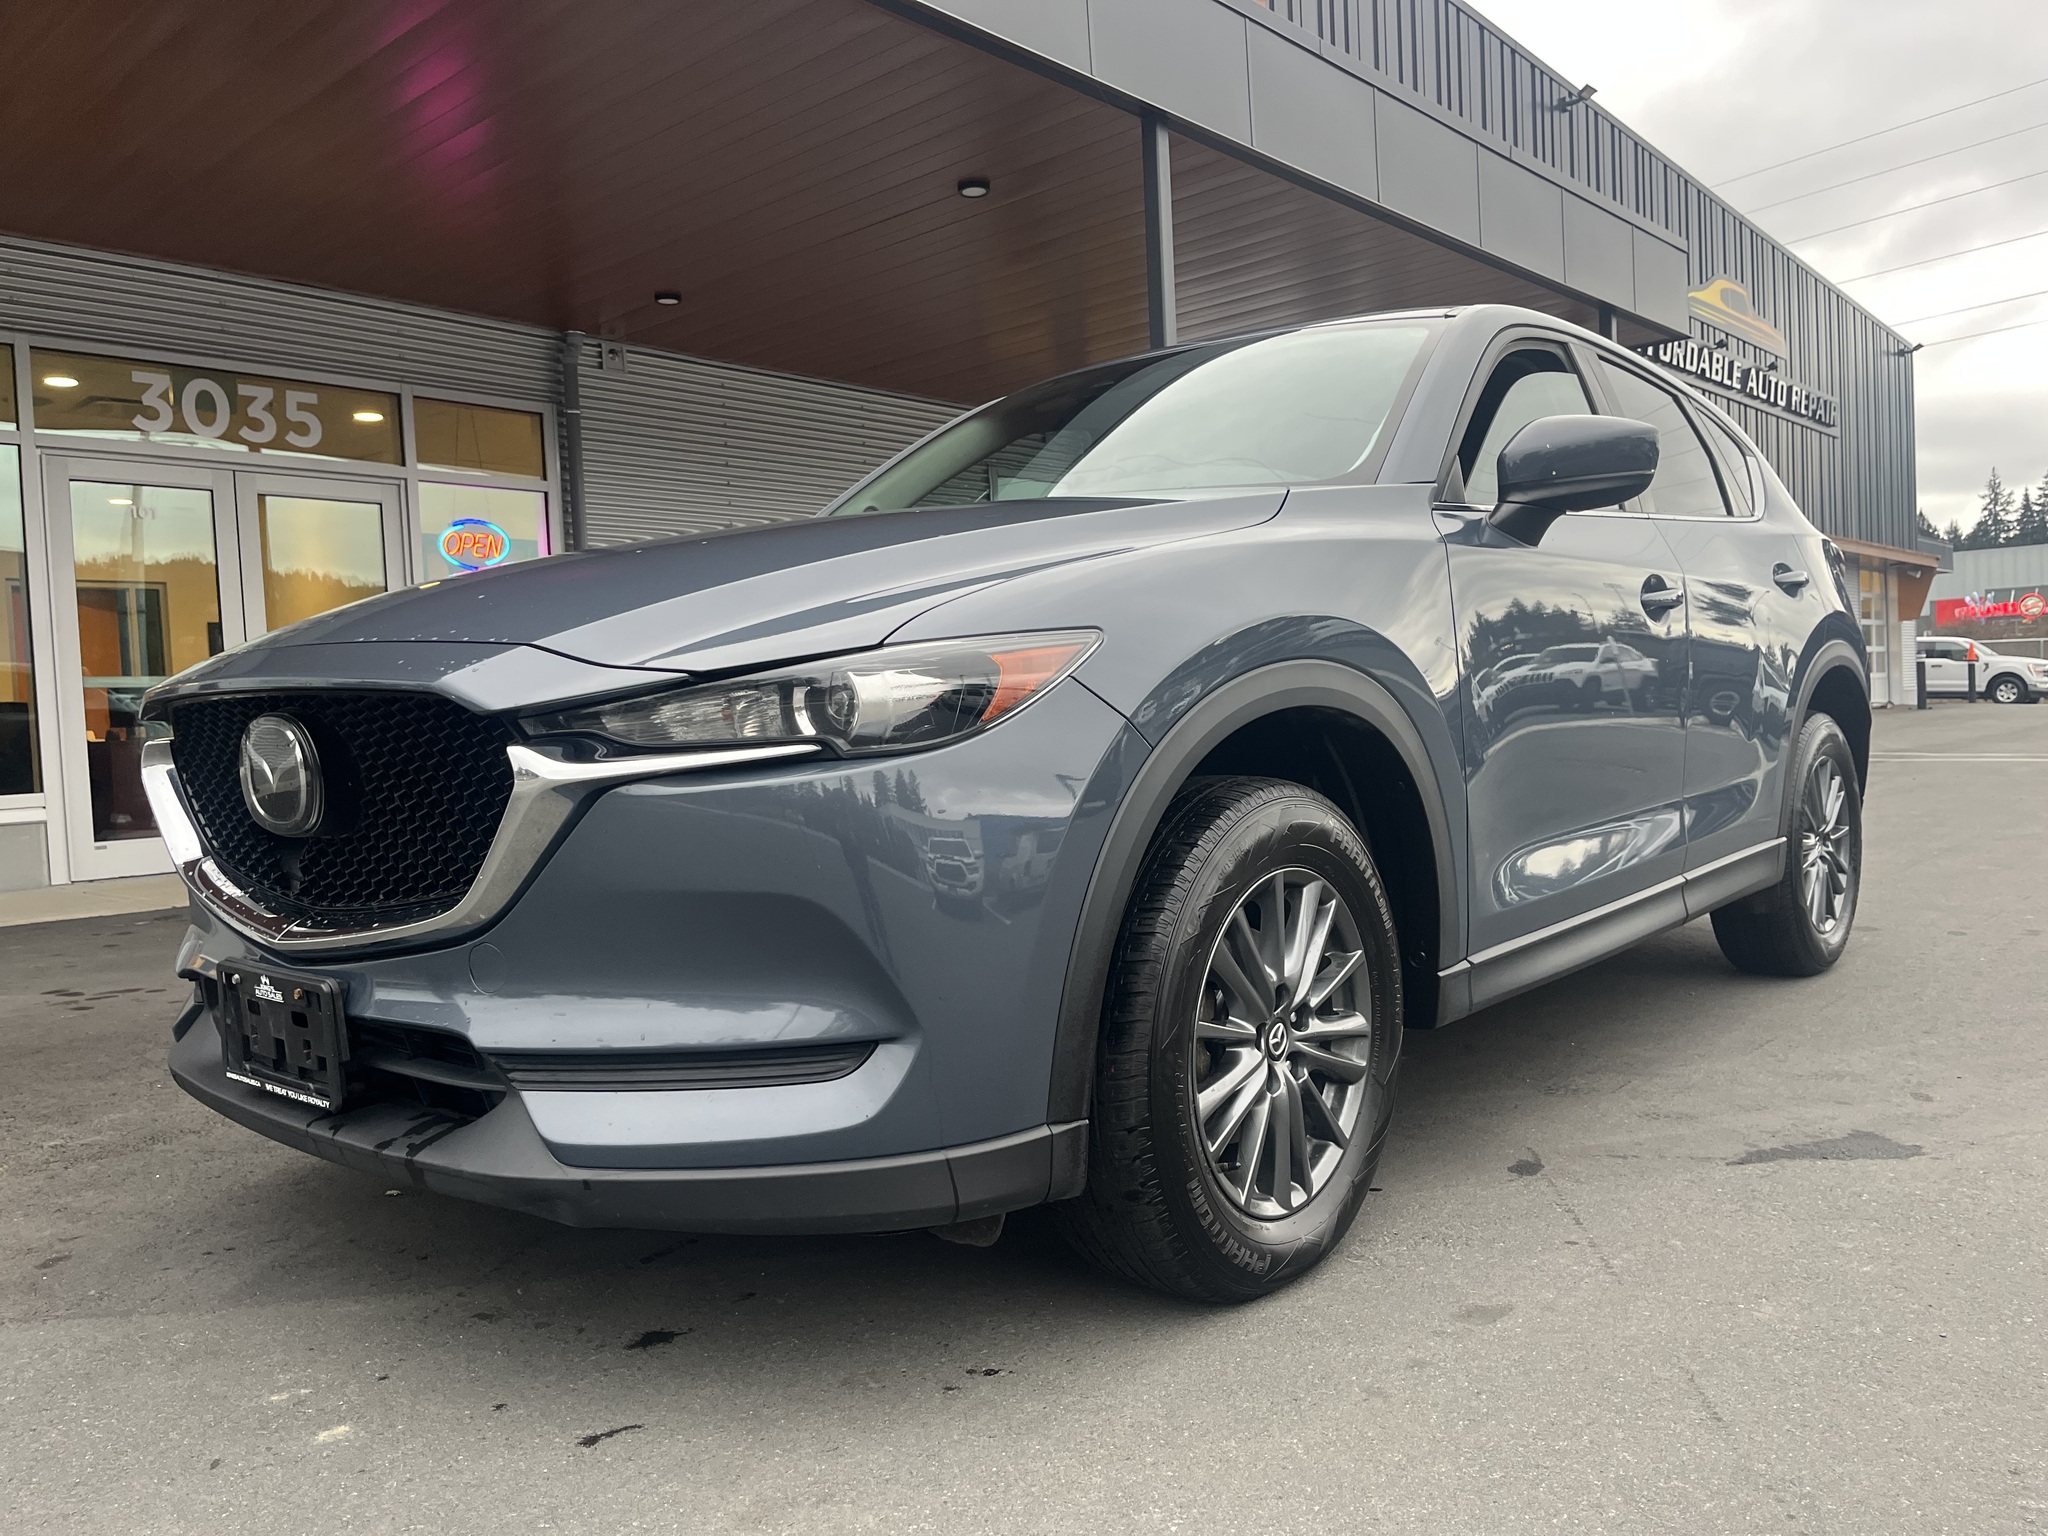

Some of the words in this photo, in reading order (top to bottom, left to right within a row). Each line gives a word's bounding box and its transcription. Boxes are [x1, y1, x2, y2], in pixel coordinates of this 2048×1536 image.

[131, 371, 322, 448] 3035
[1746, 367, 1787, 408] AUTO
[1791, 385, 1838, 427] REPAIR
[443, 531, 503, 558] OPEN
[265, 1083, 274, 1092] WE
[273, 1086, 287, 1096] TREAT
[287, 1090, 298, 1100] YOU
[297, 1093, 308, 1103] LIKE
[307, 1096, 330, 1109] ROYALTY
[1186, 1177, 1272, 1275] PHANTOM
